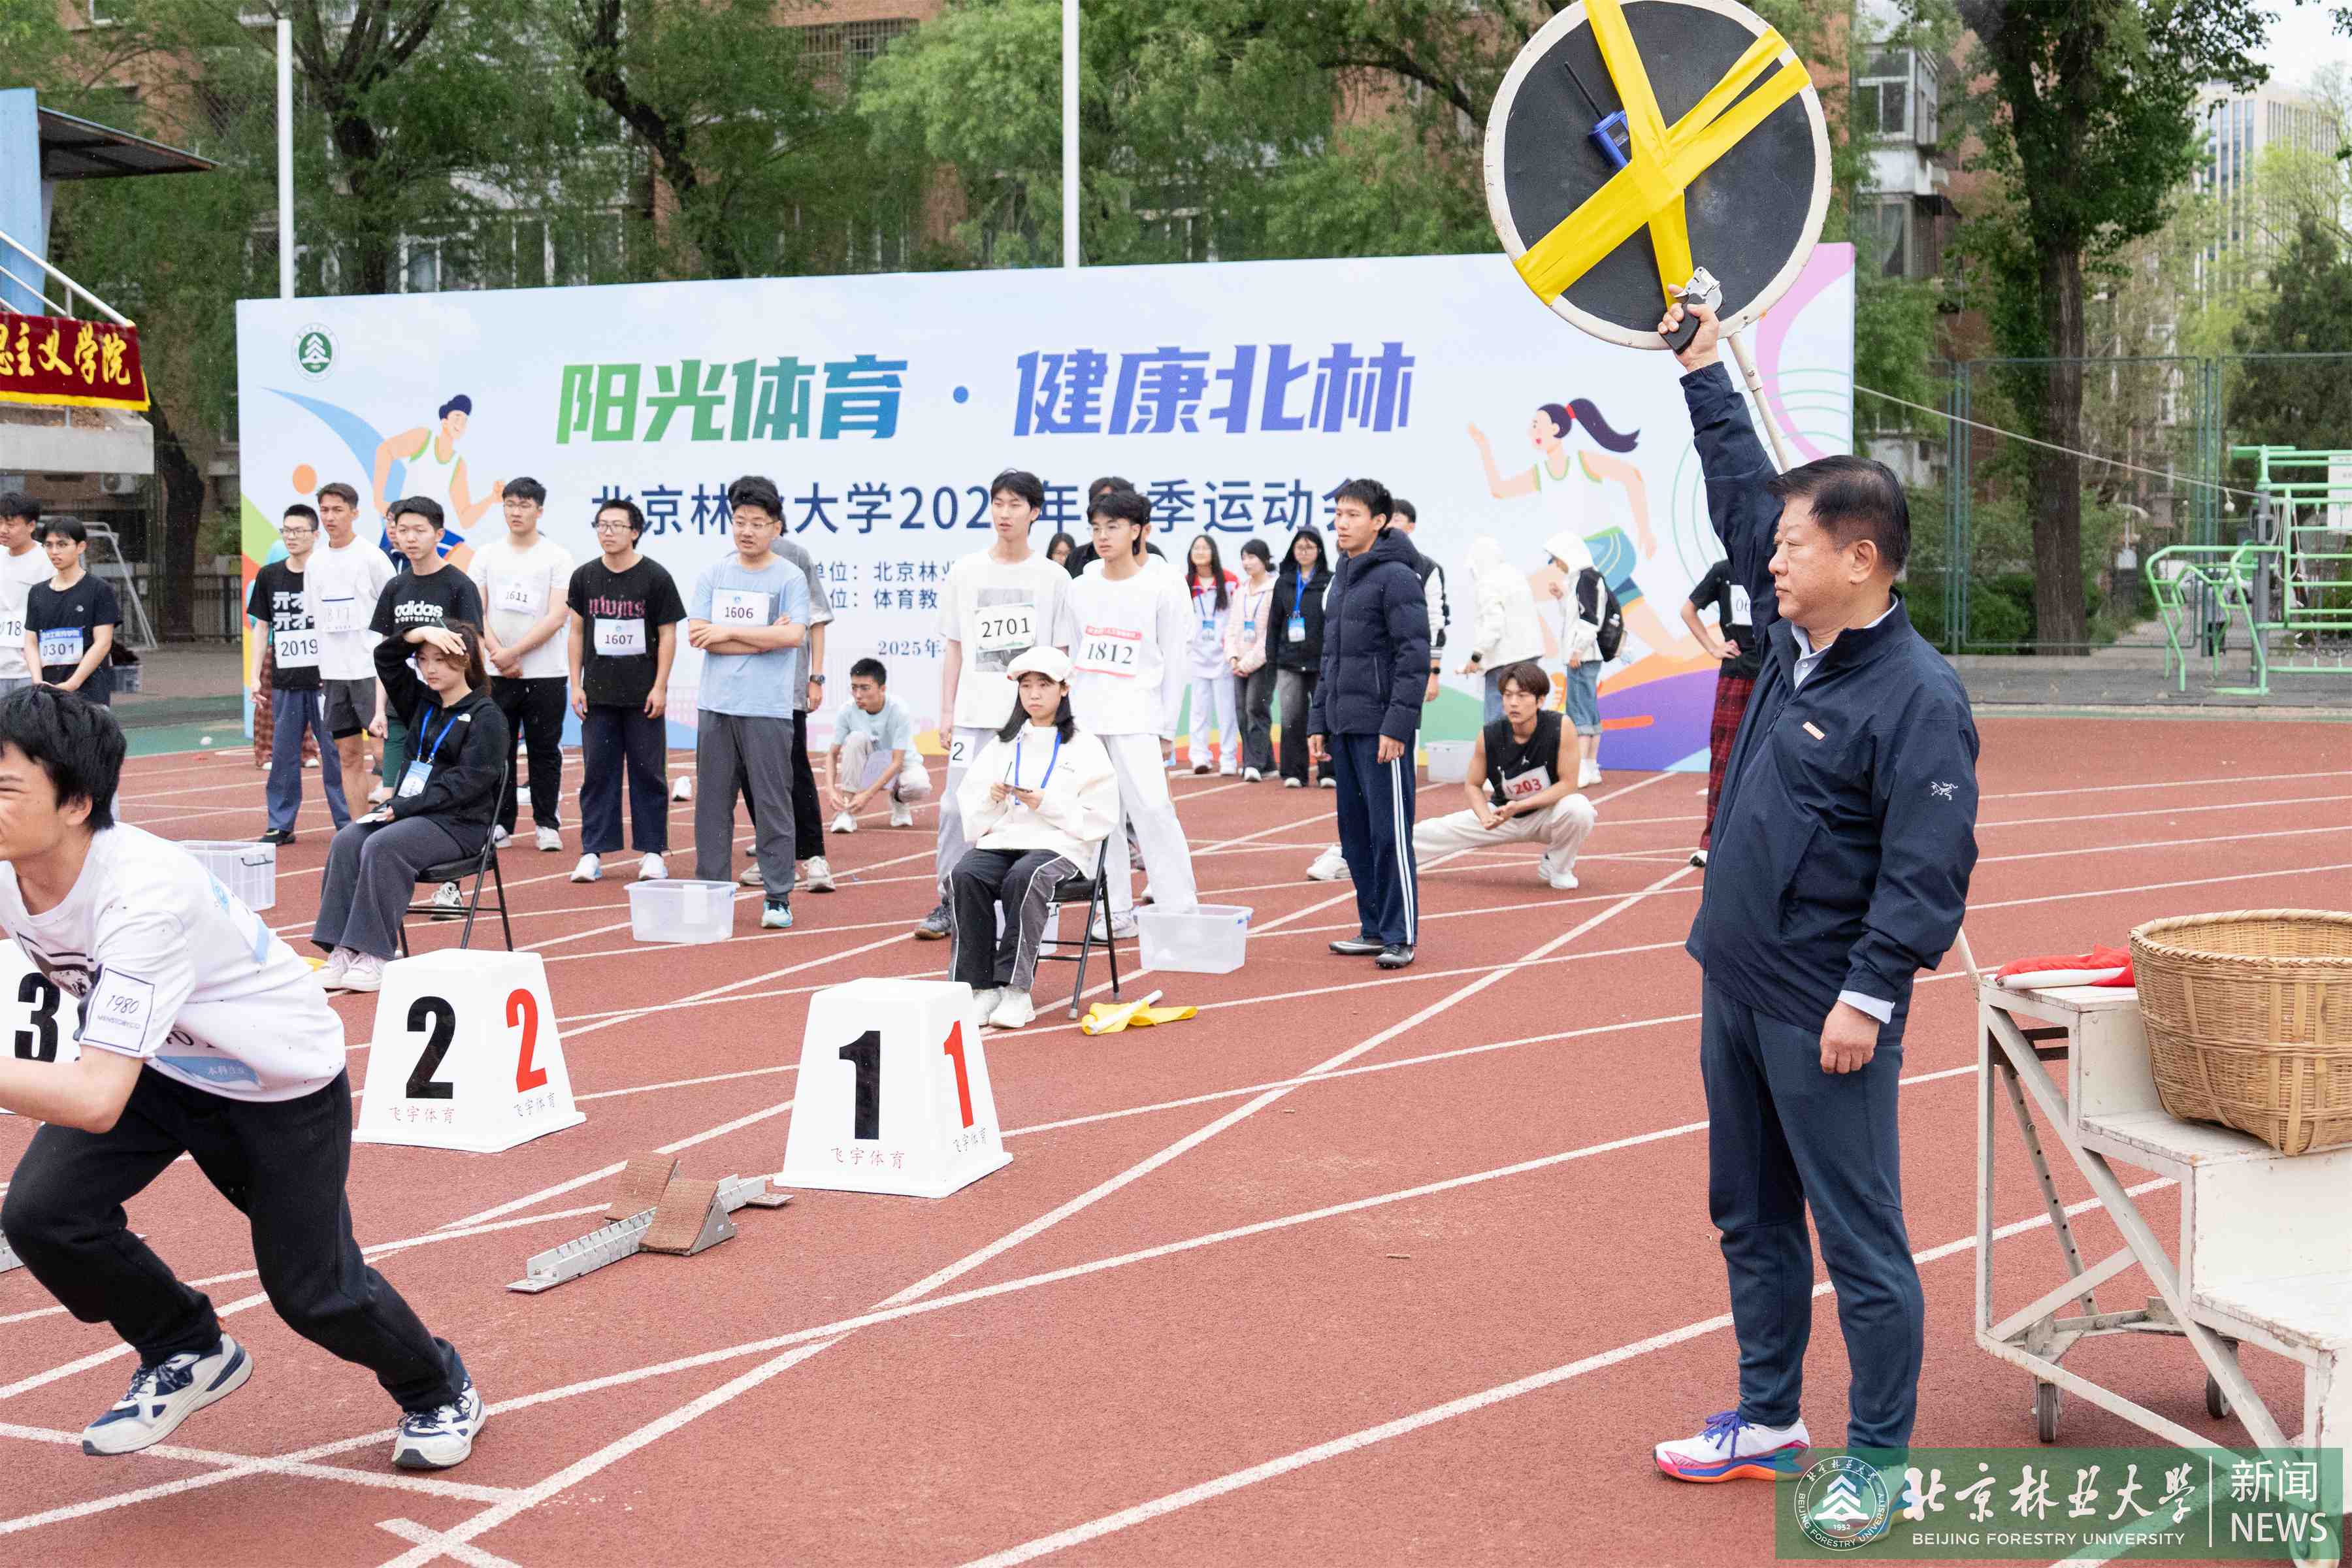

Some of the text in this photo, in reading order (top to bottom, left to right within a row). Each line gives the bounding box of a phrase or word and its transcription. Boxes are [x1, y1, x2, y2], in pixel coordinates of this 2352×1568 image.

[556, 353, 908, 445] 阳光体育
[1013, 340, 1416, 436] 健康北林
[591, 479, 1351, 536] 京林大学202年季运动
[394, 600, 443, 617] adidas
[725, 606, 753, 619] 1606
[0, 621, 22, 636] 18
[981, 617, 1030, 638] 2701
[281, 638, 319, 657] 2019
[605, 634, 634, 645] 1607
[877, 638, 946, 659] 2025年
[1087, 642, 1134, 664] 1812
[106, 995, 140, 1014] 1980
[14, 972, 61, 1063] 3
[406, 996, 455, 1100] 2
[506, 988, 547, 1093] 2
[839, 1030, 881, 1140] 1
[943, 1020, 974, 1129] 1
[389, 1105, 455, 1124] 飞宇体育
[830, 1147, 906, 1169] 飞宇体育
